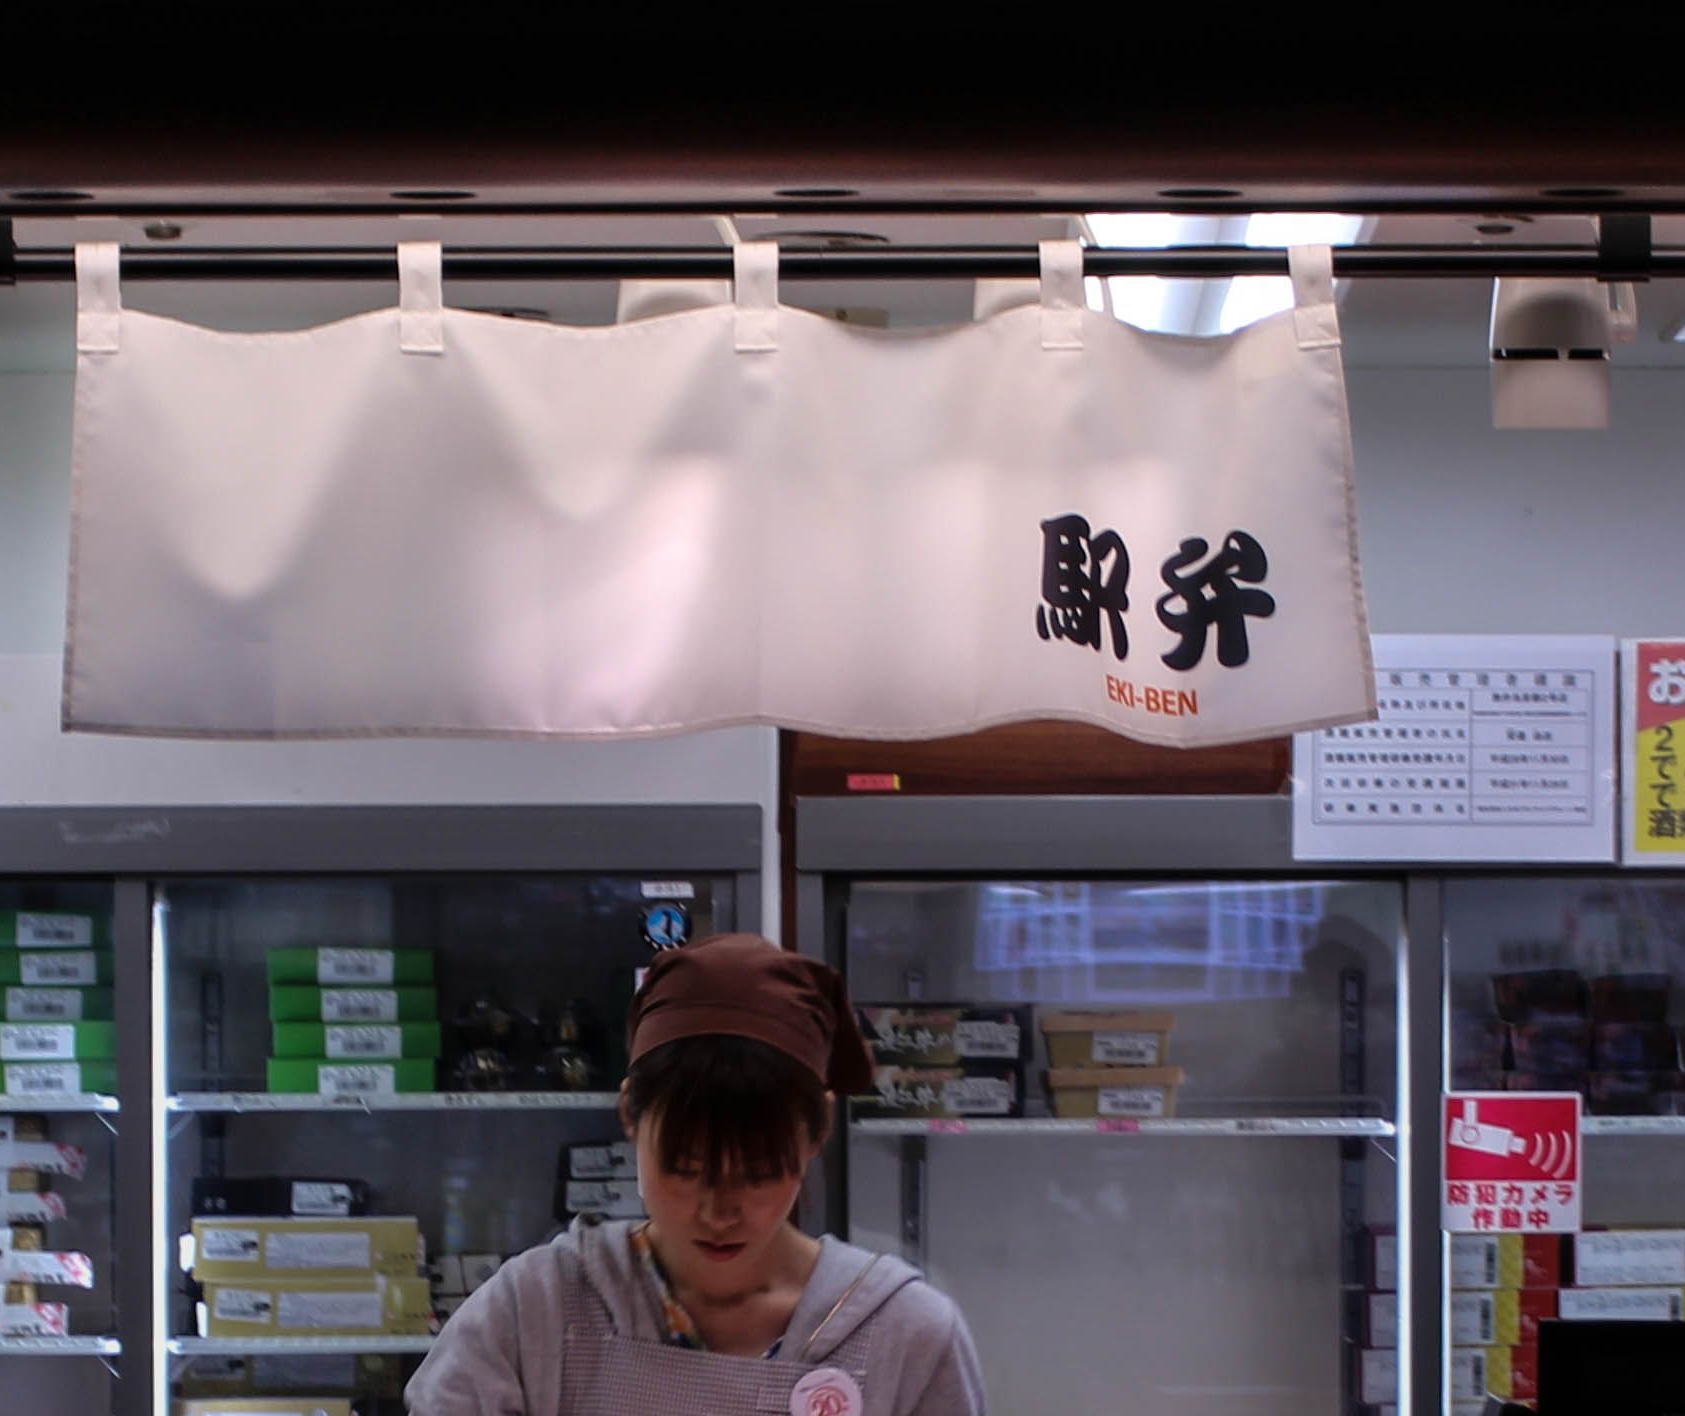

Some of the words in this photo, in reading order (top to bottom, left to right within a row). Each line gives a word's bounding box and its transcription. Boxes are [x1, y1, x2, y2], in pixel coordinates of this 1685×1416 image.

[1037, 513, 1275, 671] 駅弁
[1106, 674, 1198, 716] EKI-BEN
[1448, 1184, 1573, 1205] 防犯カメラ
[1473, 1207, 1549, 1229] 作動中
